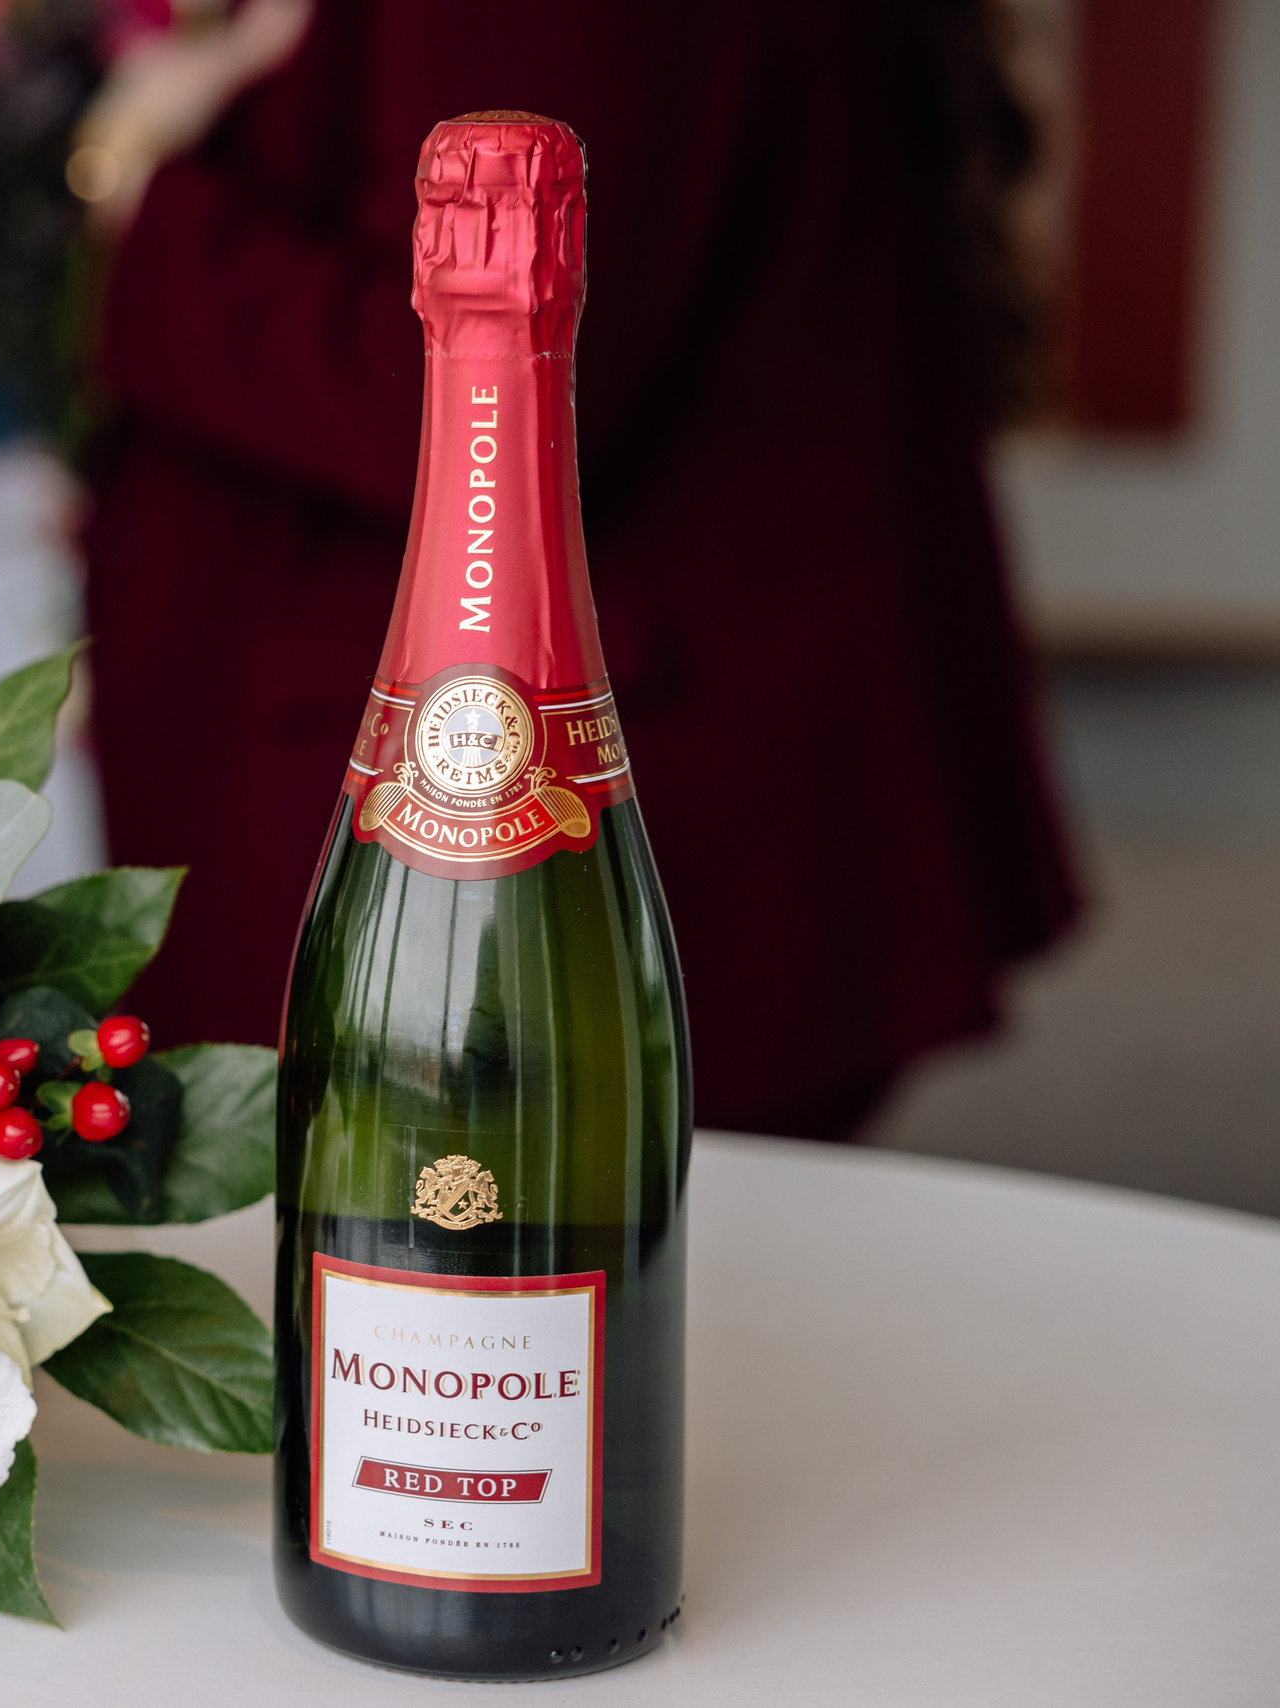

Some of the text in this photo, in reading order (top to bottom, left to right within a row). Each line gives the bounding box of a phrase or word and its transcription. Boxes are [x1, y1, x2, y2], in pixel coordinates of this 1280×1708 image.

[458, 385, 499, 634] MONOPOLE
[453, 733, 493, 747] H&C
[436, 758, 508, 785] REIMS
[419, 778, 524, 808] MAISON FONDÉE EN 1785
[396, 802, 545, 848] MONOPOLE
[374, 1325, 532, 1350] CHAMPAGNE
[331, 1347, 580, 1401] MONOPOLE
[383, 1468, 517, 1497] RED TOP
[423, 1518, 473, 1531] SEC
[379, 1530, 419, 1542] MAISON
[425, 1537, 469, 1548] FONDÉE
